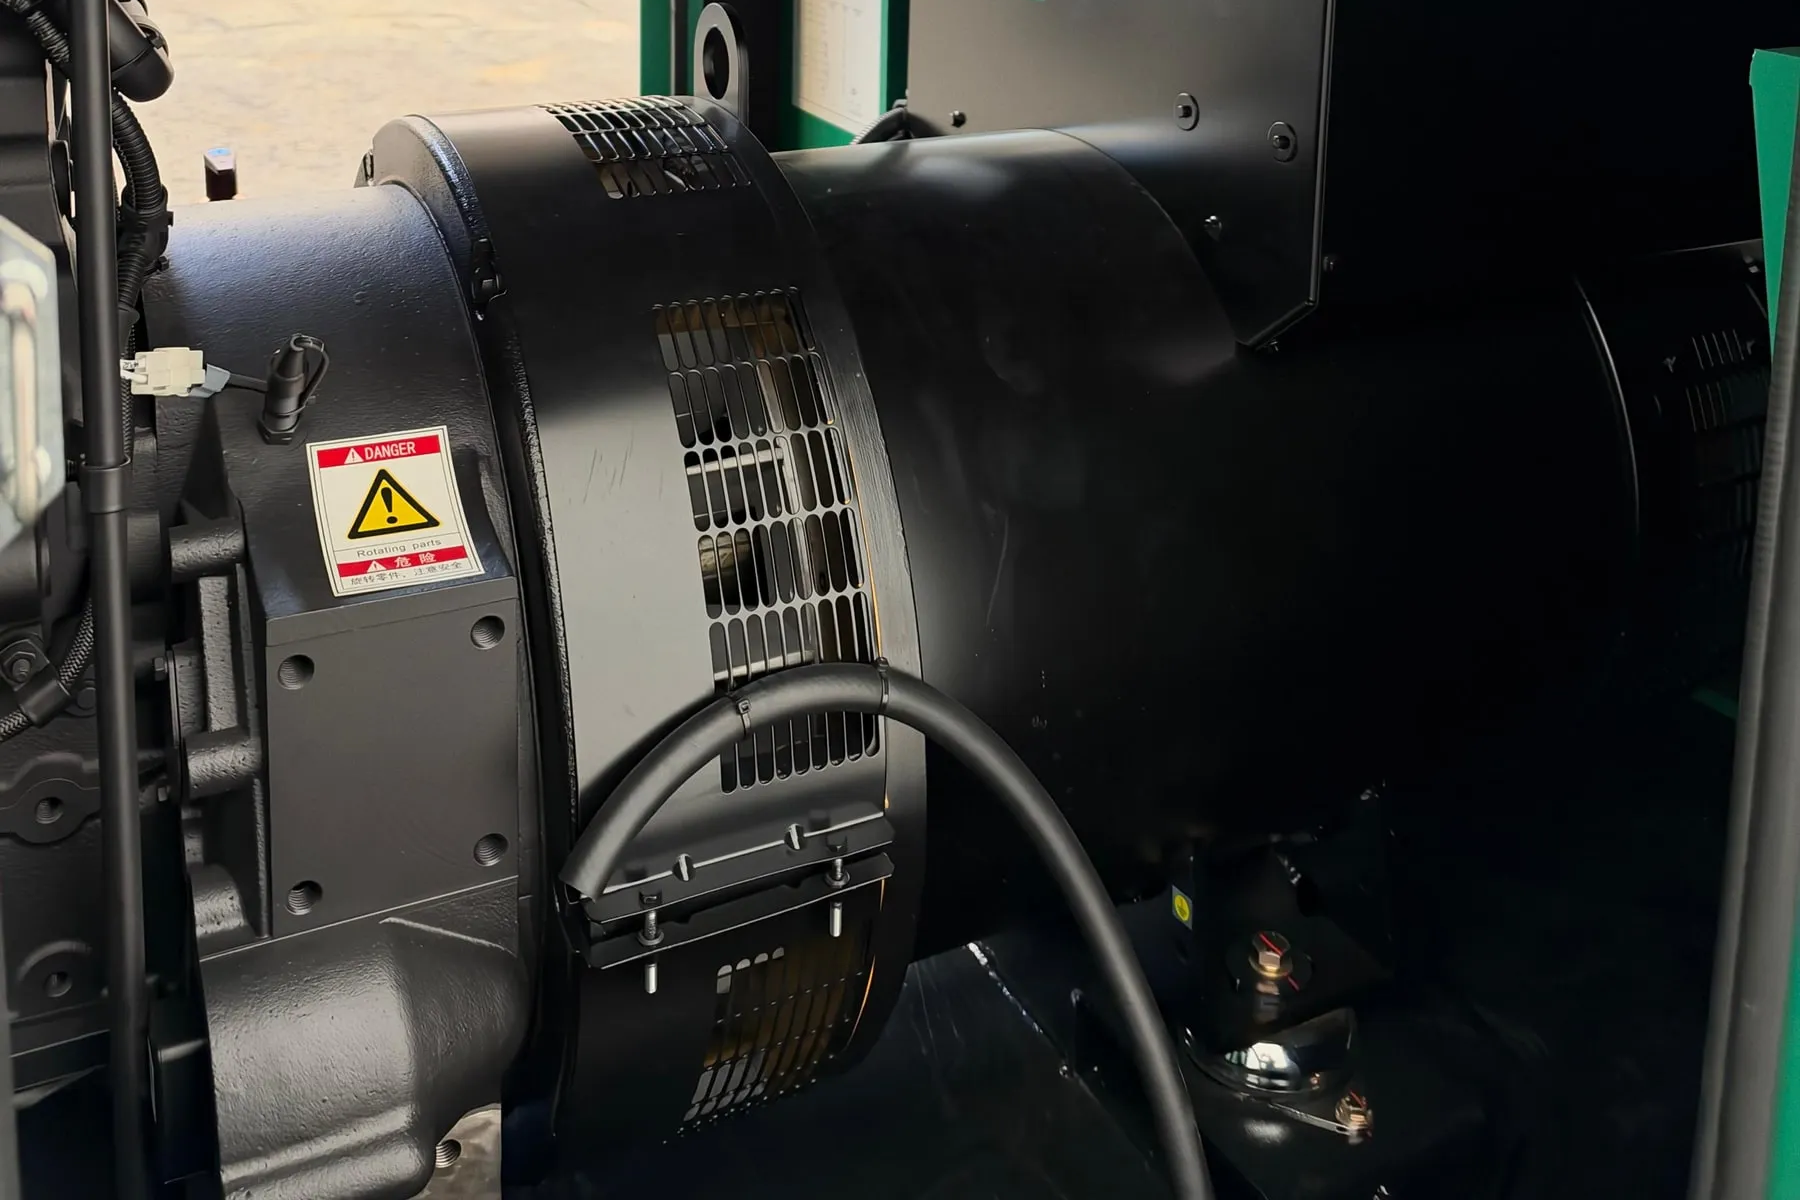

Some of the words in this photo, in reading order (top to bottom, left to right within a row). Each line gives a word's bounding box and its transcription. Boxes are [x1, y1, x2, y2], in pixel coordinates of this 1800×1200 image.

[364, 441, 416, 460] DANGER
[357, 544, 406, 558] Rotating
[412, 539, 442, 551] parts
